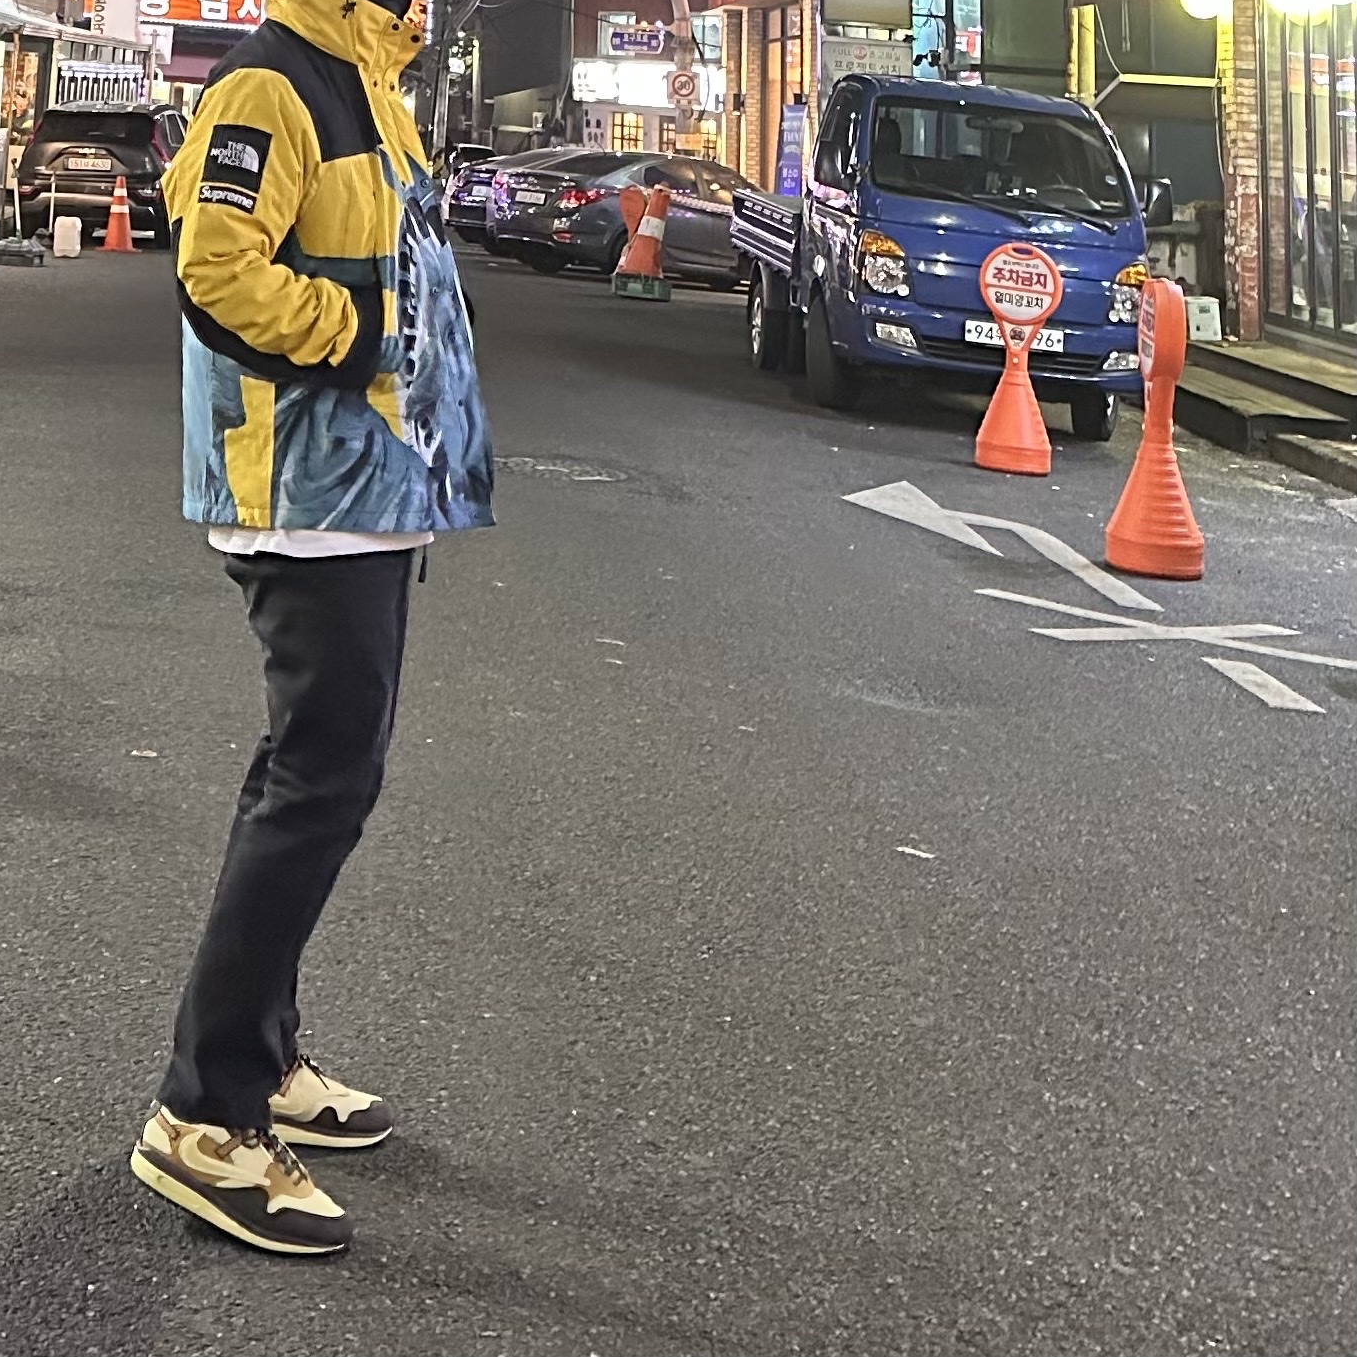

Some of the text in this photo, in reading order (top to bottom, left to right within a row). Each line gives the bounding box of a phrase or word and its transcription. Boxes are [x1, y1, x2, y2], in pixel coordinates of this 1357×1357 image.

[676, 79, 691, 91] 30
[200, 185, 254, 209] Supreme
[992, 266, 1048, 289] 주차금지
